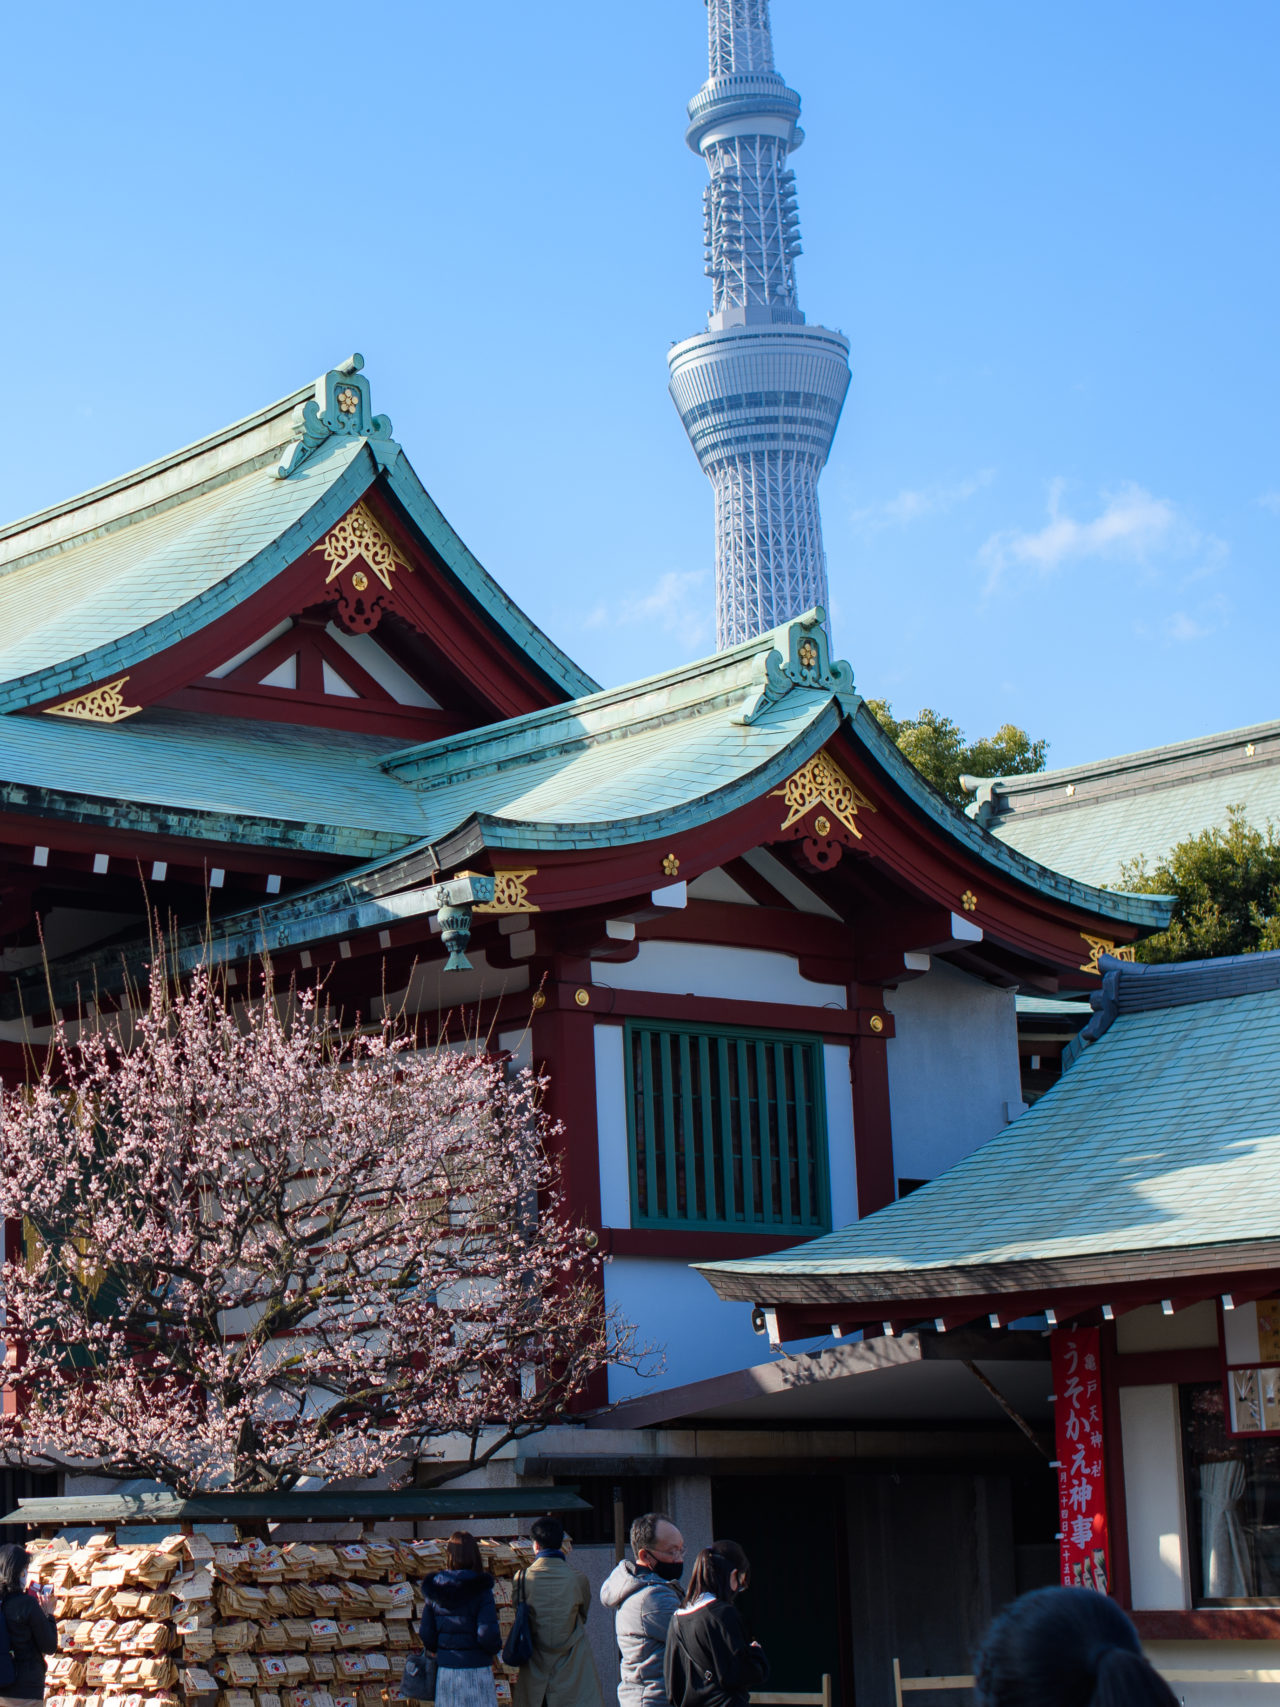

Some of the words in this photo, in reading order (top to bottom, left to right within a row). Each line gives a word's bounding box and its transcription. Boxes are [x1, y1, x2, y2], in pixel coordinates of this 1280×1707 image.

[1063, 1341, 1094, 1550] うそかえ神事
[1083, 1353, 1102, 1478] 亀戸天神社
